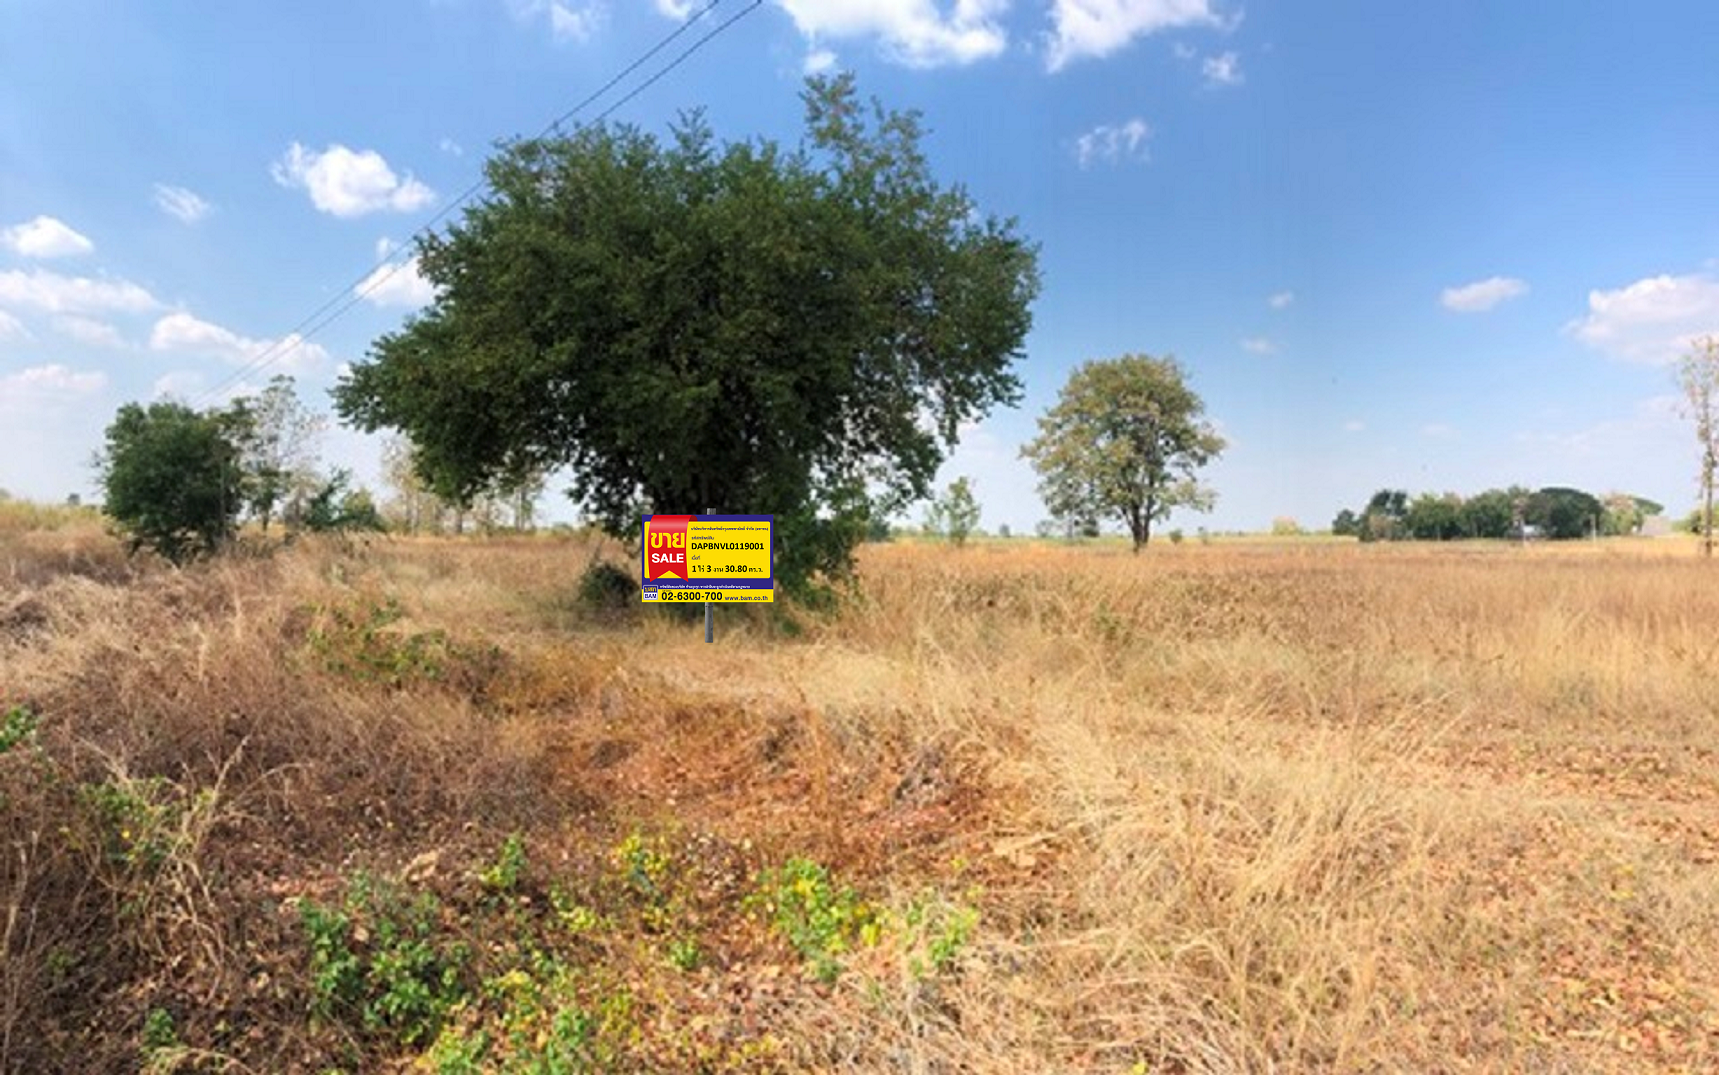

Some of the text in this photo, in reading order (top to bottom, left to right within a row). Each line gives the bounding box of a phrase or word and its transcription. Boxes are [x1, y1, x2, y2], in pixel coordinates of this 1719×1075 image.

[651, 532, 685, 548] ขาย
[652, 553, 684, 563] SALE
[661, 592, 722, 600] 02-6300-700
